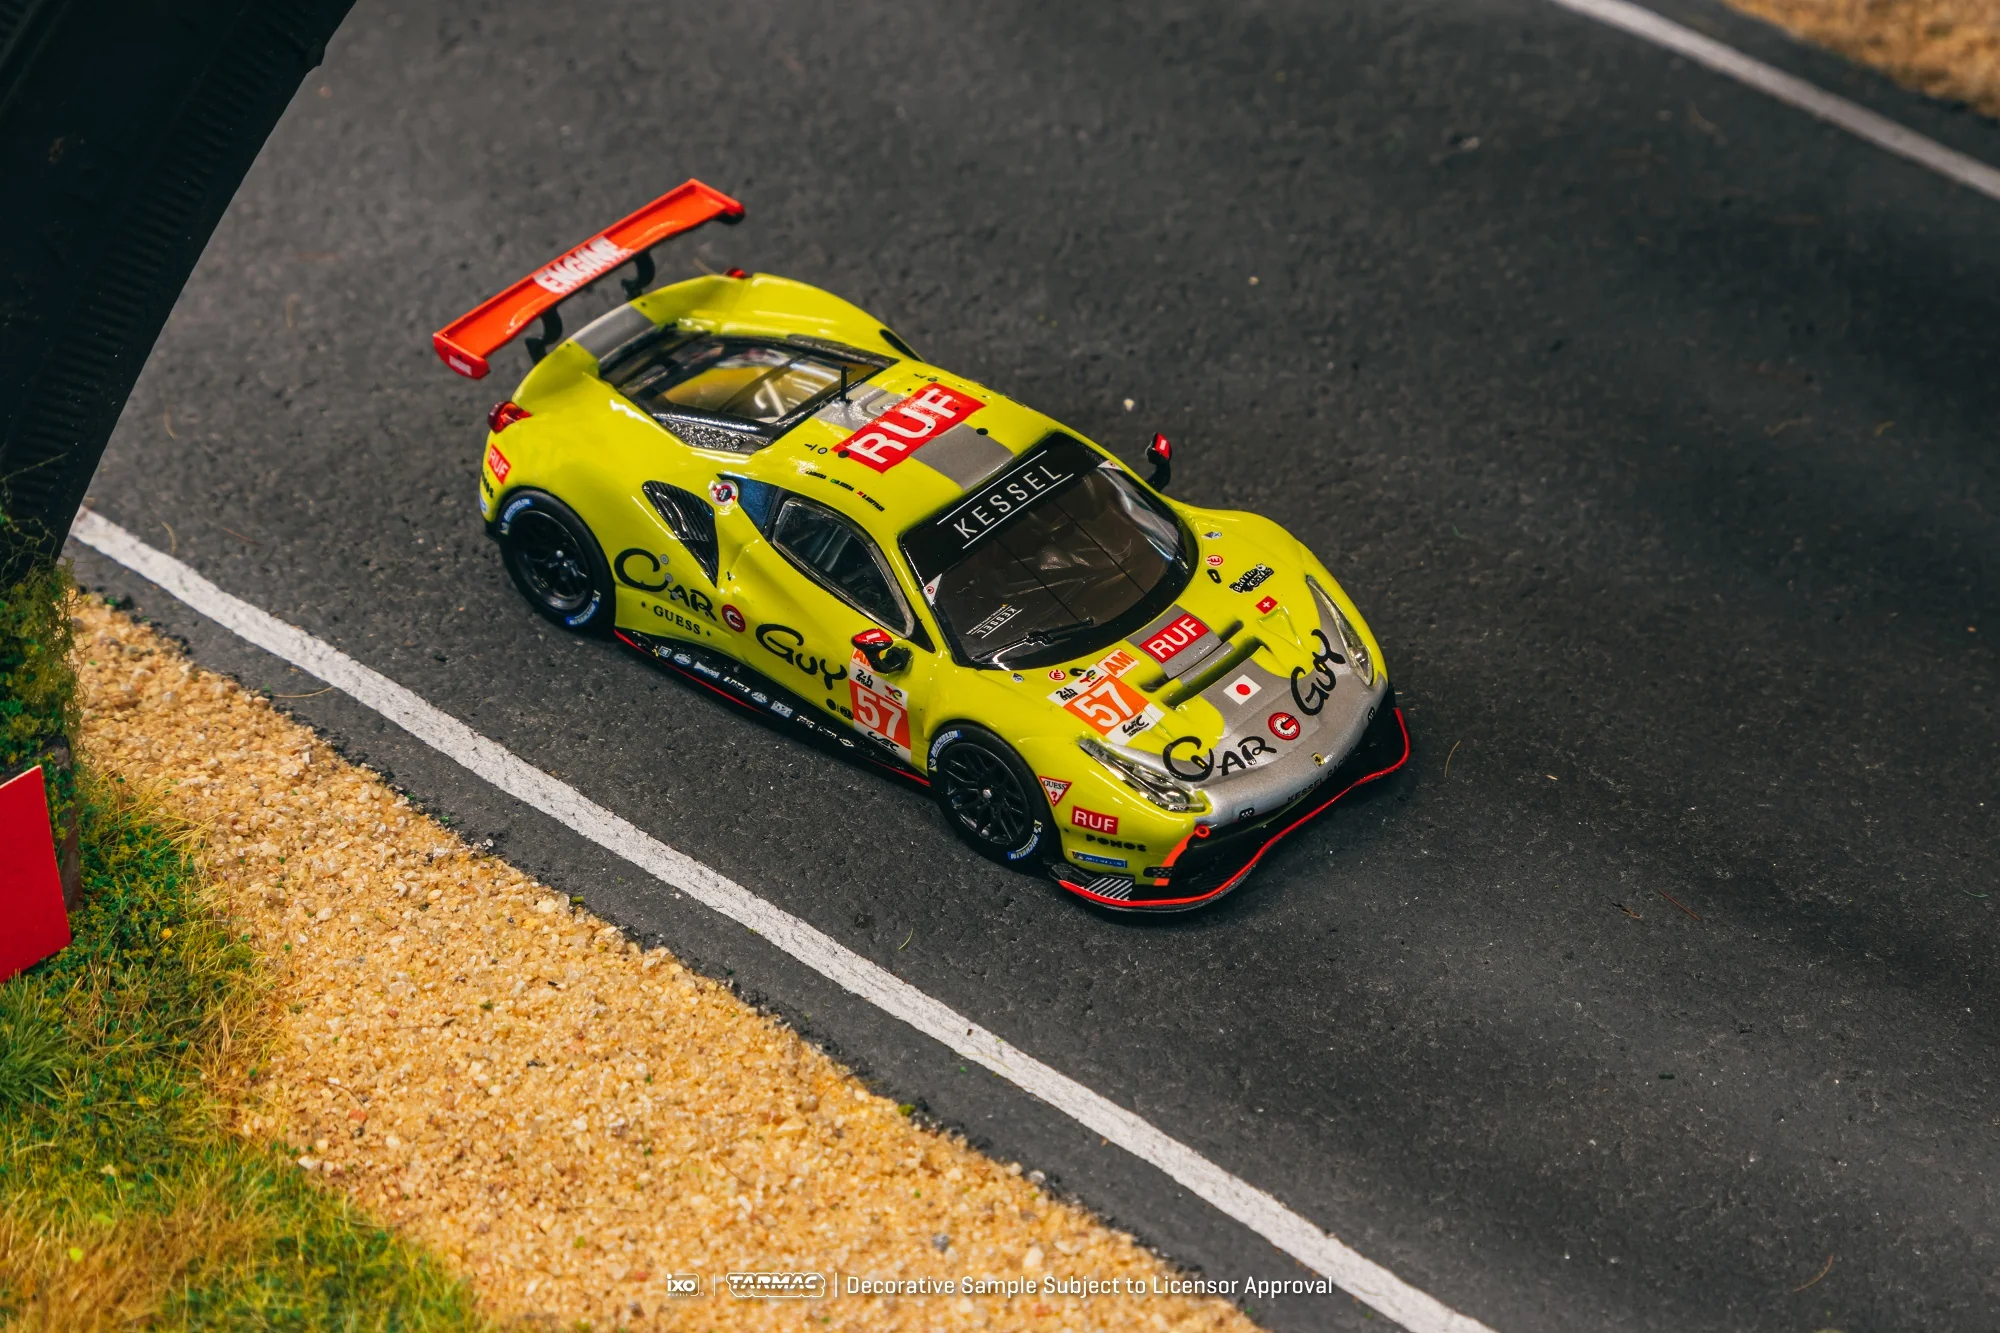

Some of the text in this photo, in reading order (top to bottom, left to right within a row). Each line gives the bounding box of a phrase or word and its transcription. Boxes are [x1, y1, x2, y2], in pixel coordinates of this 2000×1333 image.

[846, 387, 958, 464] RUF
[489, 447, 509, 477] RUF
[953, 465, 1062, 540] KESSEL
[653, 605, 701, 635] GUESS
[1148, 618, 1198, 658] RUF
[1107, 651, 1136, 676] AM
[857, 686, 902, 739] 57
[1073, 680, 1134, 727] 57
[1043, 780, 1066, 790] GUESS
[1074, 810, 1115, 832] RUF
